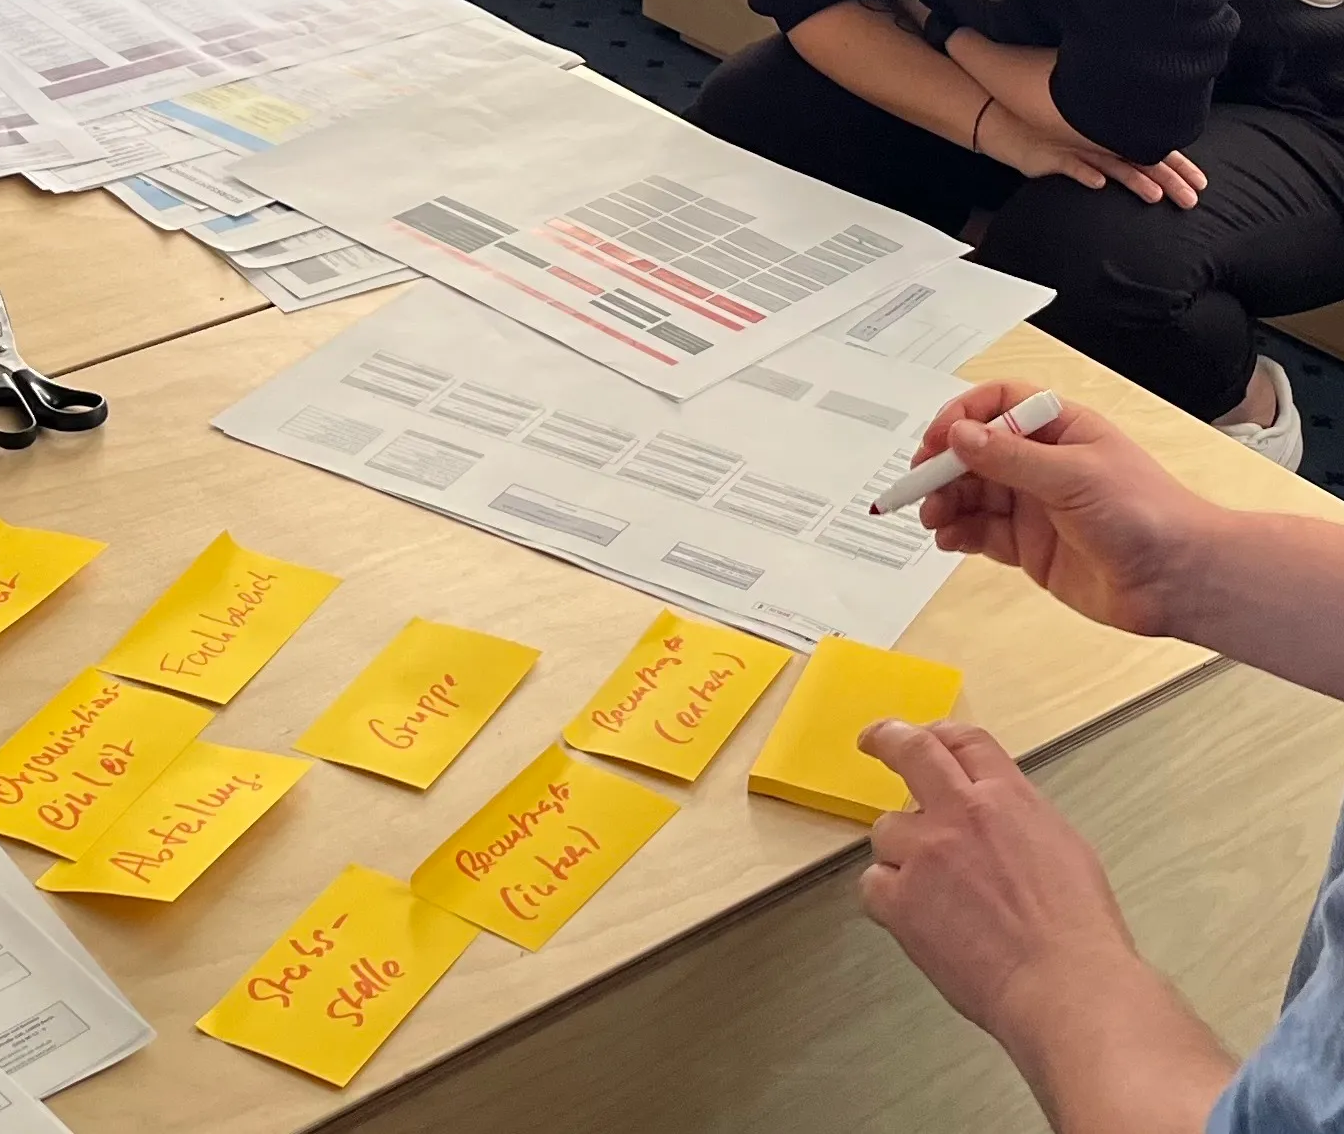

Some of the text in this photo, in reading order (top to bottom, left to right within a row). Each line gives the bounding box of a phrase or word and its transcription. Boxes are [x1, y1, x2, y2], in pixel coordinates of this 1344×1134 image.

[159, 570, 279, 677] Fachbereich
[368, 673, 460, 750] Gruppe
[247, 913, 349, 1008] Stabs-
